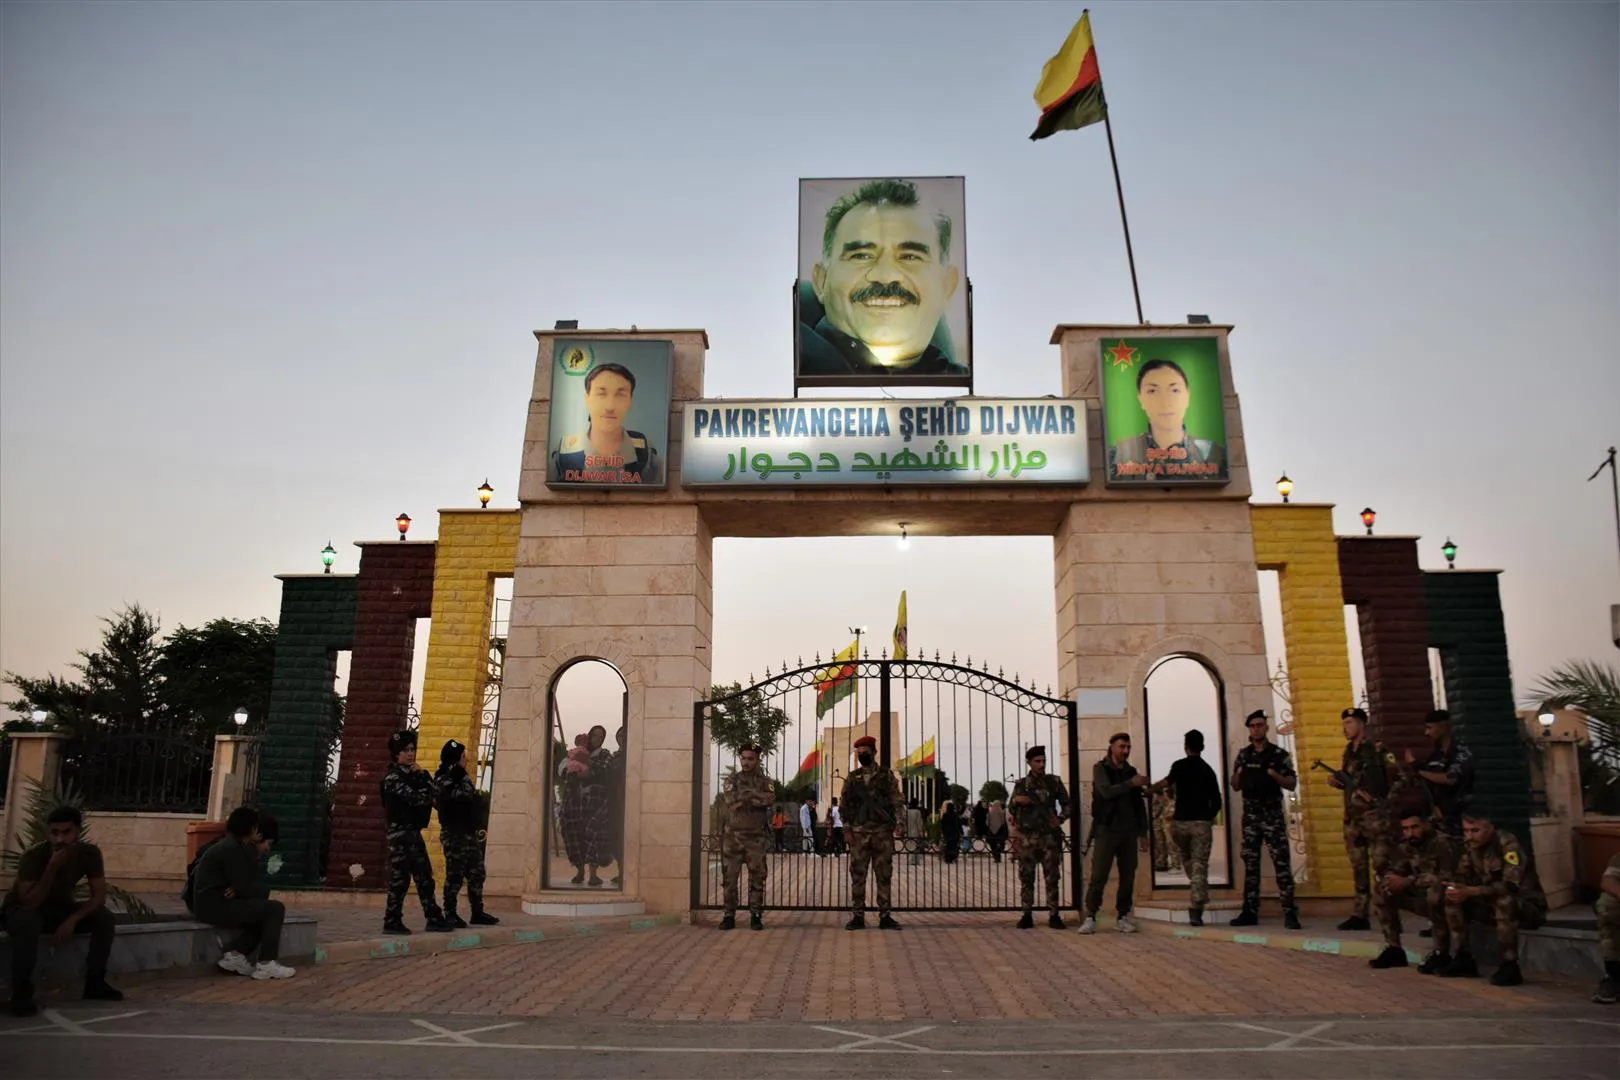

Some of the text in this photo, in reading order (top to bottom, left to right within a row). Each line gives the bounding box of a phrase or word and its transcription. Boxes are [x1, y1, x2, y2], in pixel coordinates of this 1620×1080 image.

[694, 400, 1076, 442] PAKREWANGEHA ŞEHÎD DIJWAR
[722, 439, 1047, 480] مزار الشهيد دجوار
